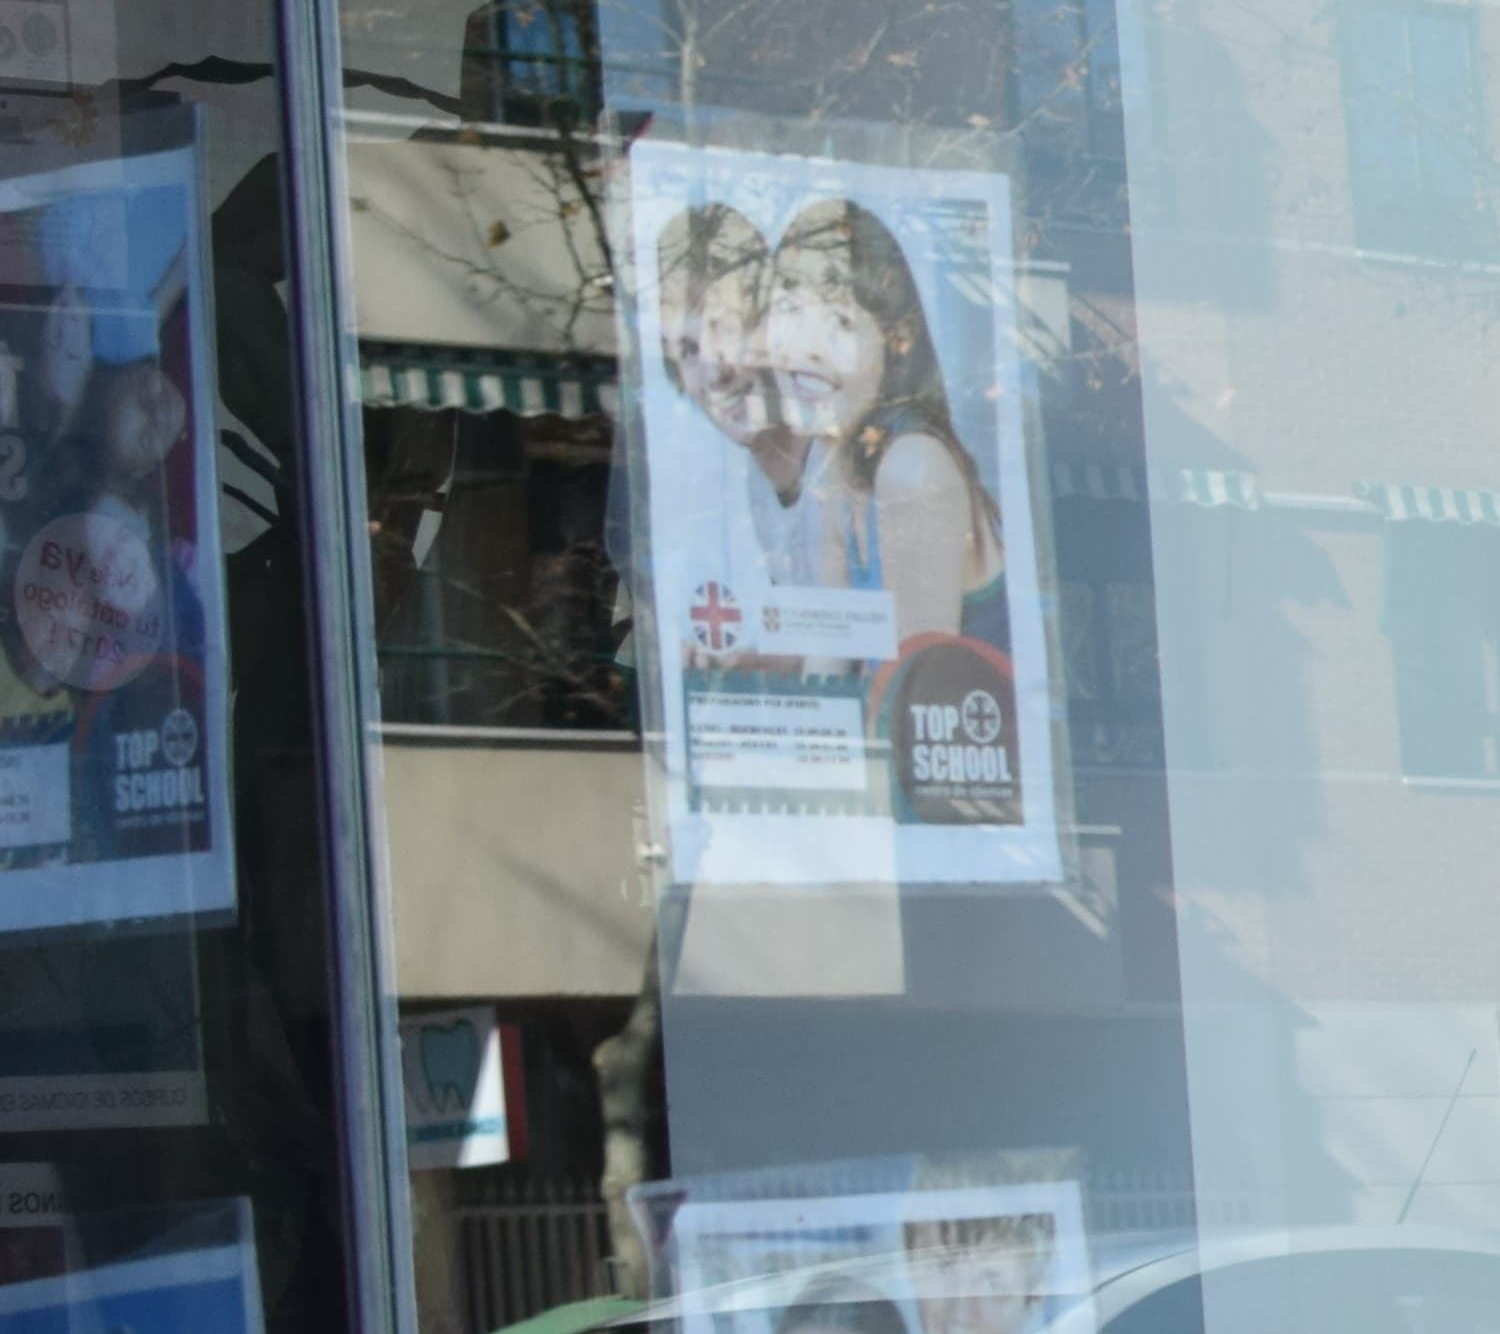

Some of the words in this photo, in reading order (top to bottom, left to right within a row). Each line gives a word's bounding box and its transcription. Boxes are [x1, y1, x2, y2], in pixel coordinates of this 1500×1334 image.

[910, 703, 959, 742] TOP
[115, 730, 159, 770] TOP
[913, 743, 1013, 784] SCHOOL
[114, 764, 204, 813] SCHOOL
